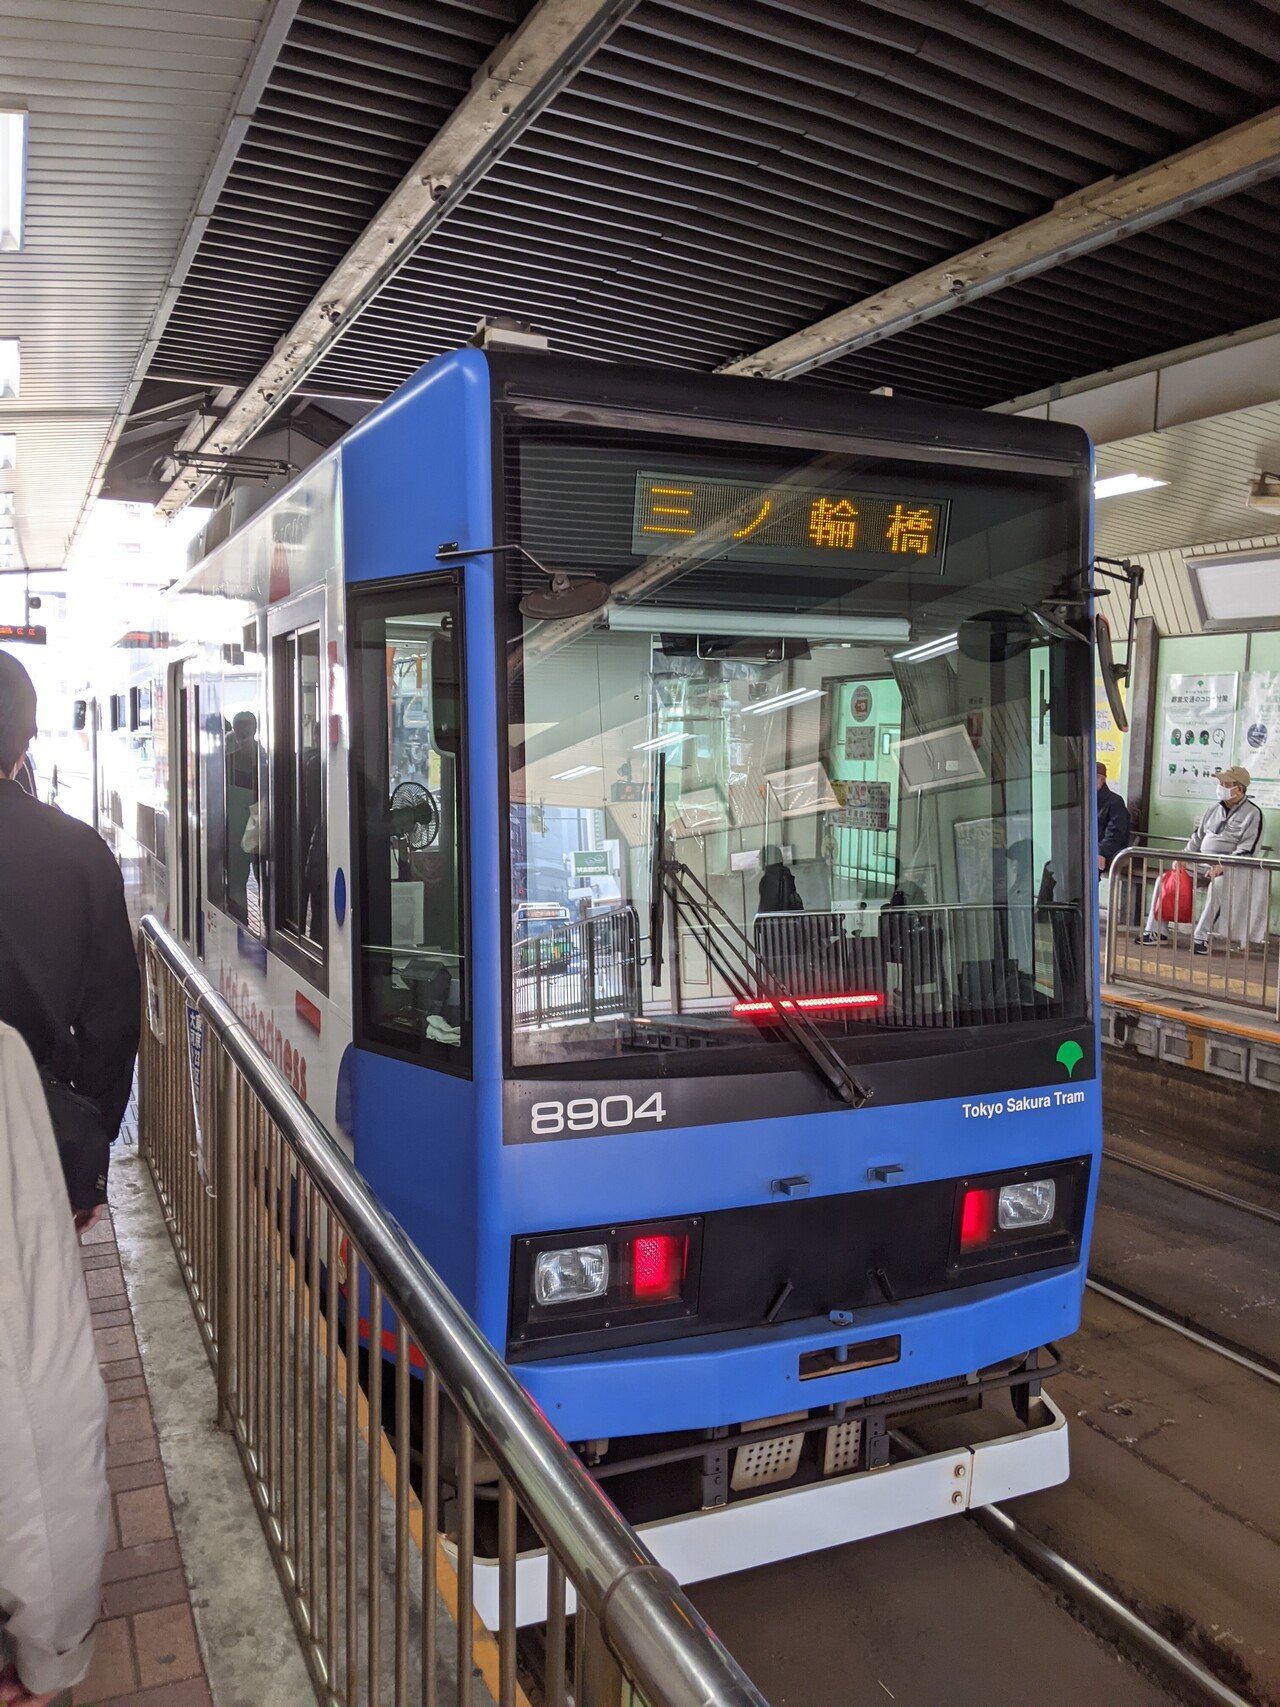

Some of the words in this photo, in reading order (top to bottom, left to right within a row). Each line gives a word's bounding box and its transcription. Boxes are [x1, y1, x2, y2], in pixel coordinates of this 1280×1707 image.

[643, 487, 933, 553] 三ノ輪橋
[531, 1091, 667, 1135] 8904
[962, 1103, 1003, 1119] Tokyo
[1006, 1096, 1051, 1112] Sakura
[1053, 1091, 1085, 1106] Tram
